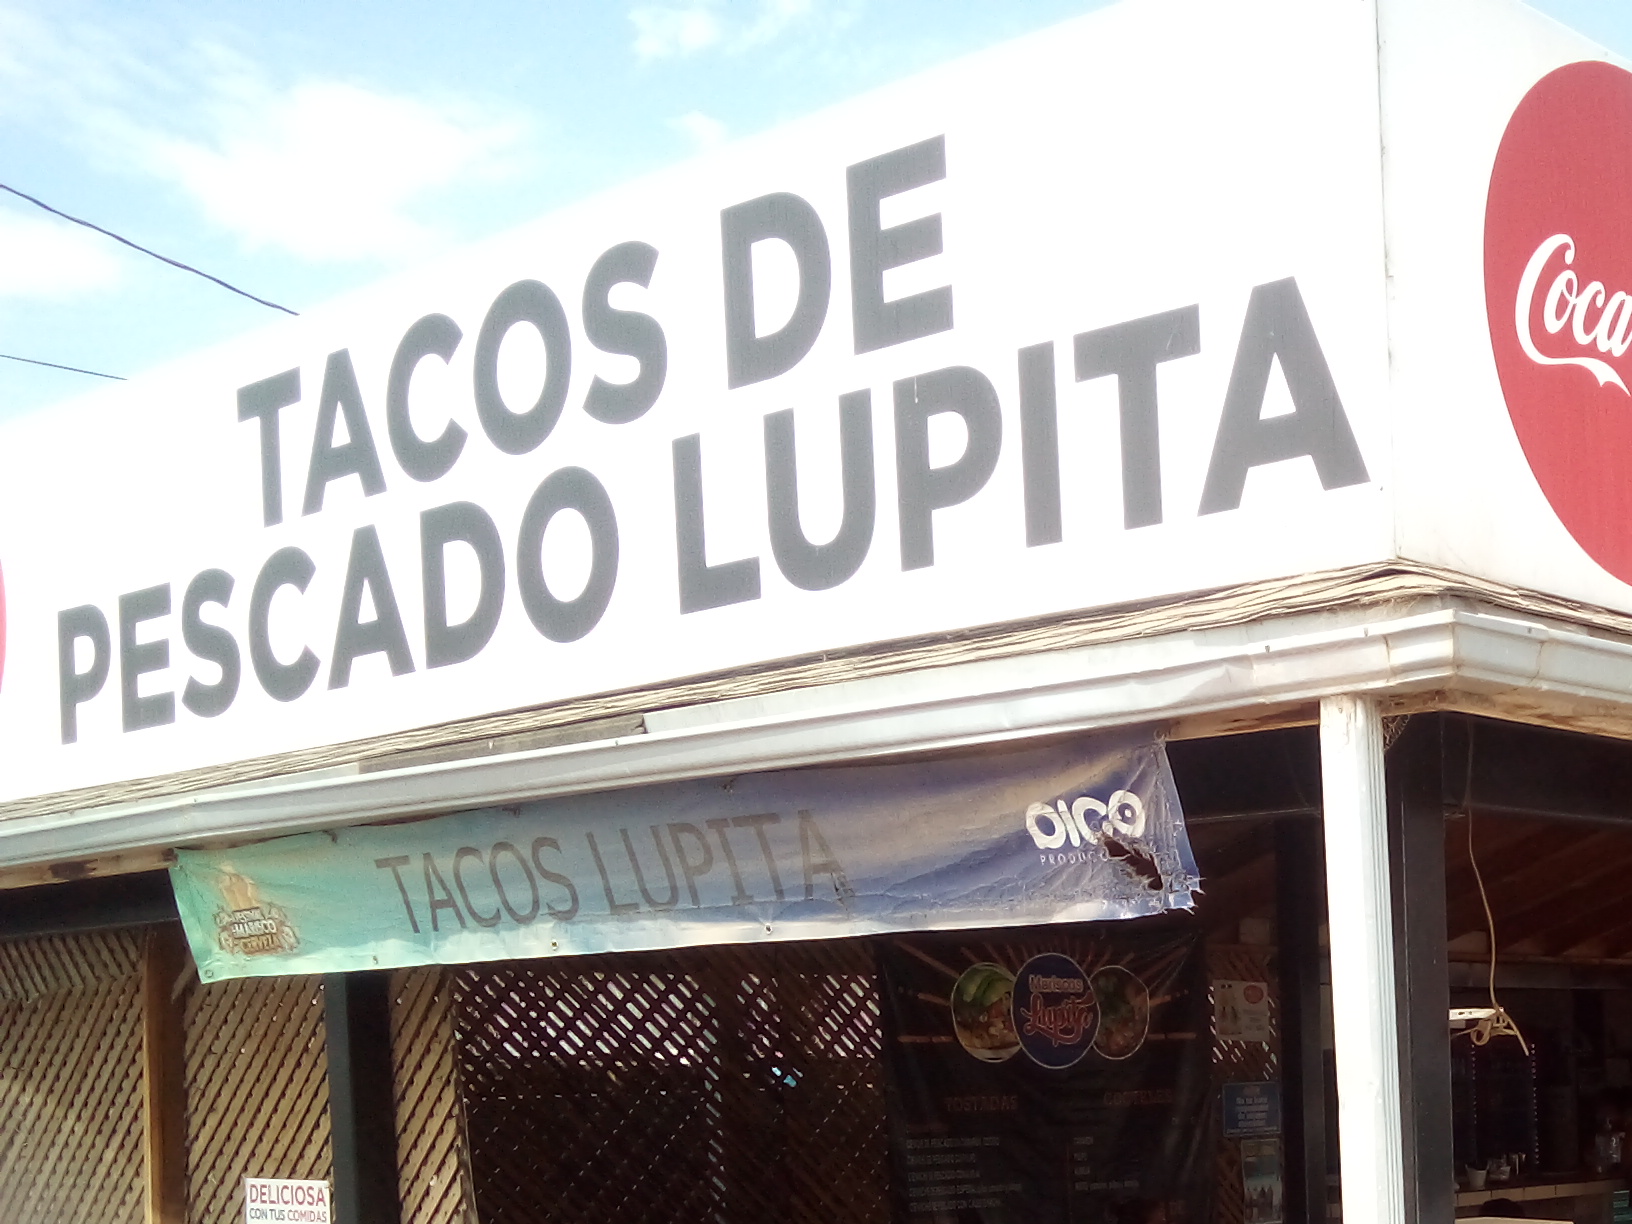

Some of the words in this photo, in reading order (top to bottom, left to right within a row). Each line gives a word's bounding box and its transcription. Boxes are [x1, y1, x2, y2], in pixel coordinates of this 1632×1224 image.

[236, 238, 669, 528] TACOS
[719, 133, 955, 391] DE
[56, 465, 620, 746] PESCADO
[670, 275, 1371, 616] LUPITA
[374, 836, 580, 934] TACOS
[586, 809, 855, 915] LUPITA
[1028, 973, 1085, 993] Mariscos
[249, 1183, 327, 1207] DELICIOSA
[249, 1208, 268, 1220] CON
[269, 1209, 286, 1221] TUS
[287, 1209, 327, 1223] COMIDAS
